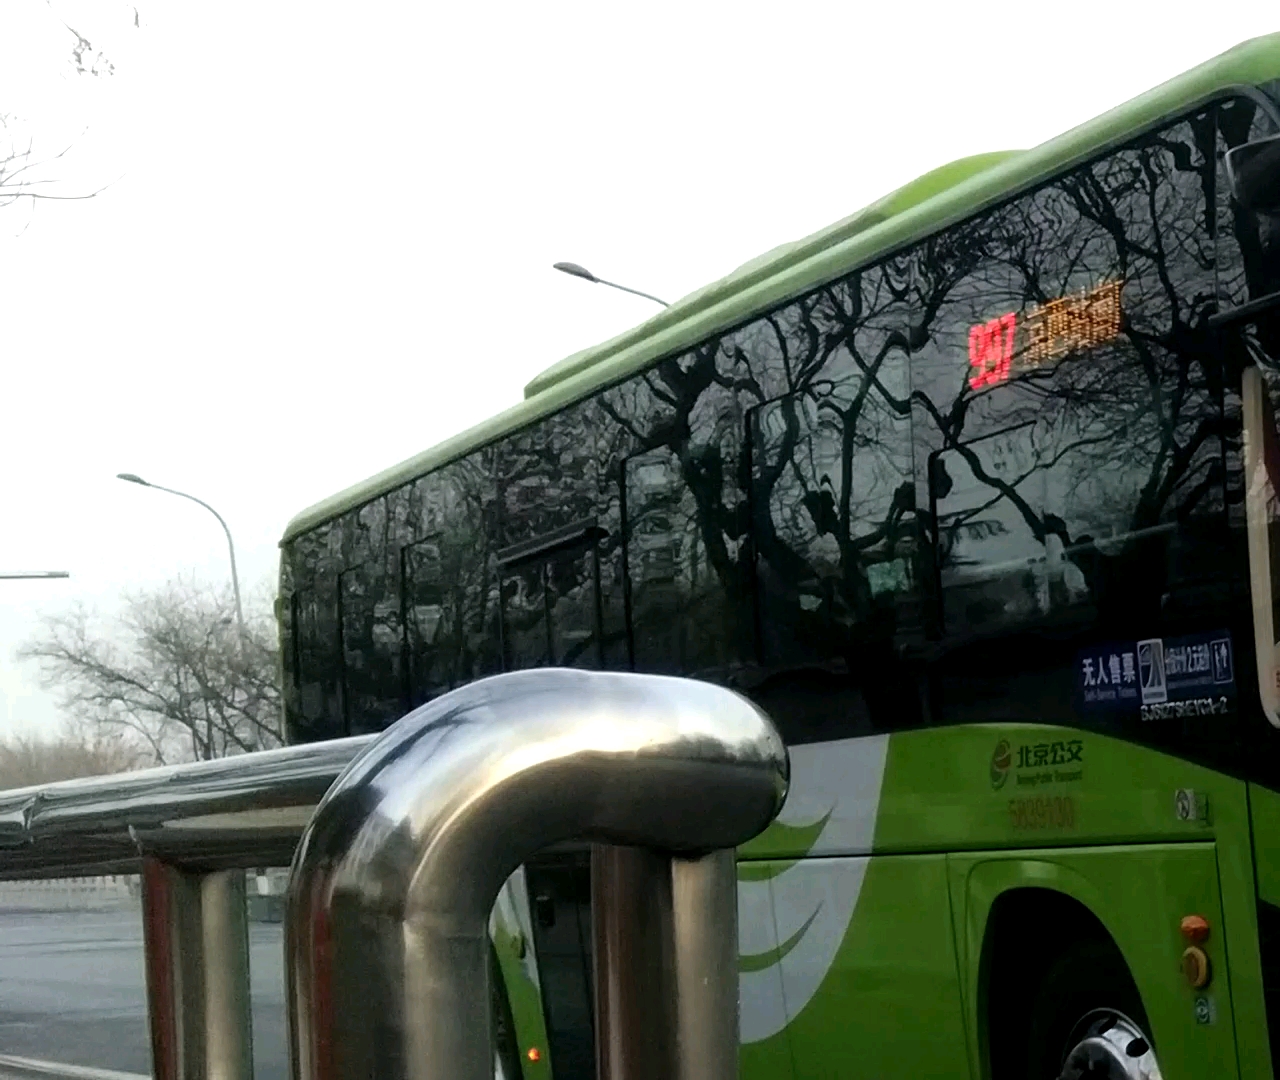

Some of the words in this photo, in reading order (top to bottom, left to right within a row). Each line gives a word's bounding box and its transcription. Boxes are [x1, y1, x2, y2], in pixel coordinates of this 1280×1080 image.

[969, 312, 1016, 390] 997
[1082, 652, 1136, 686] 无人售票
[1016, 740, 1083, 769] 北京公交
